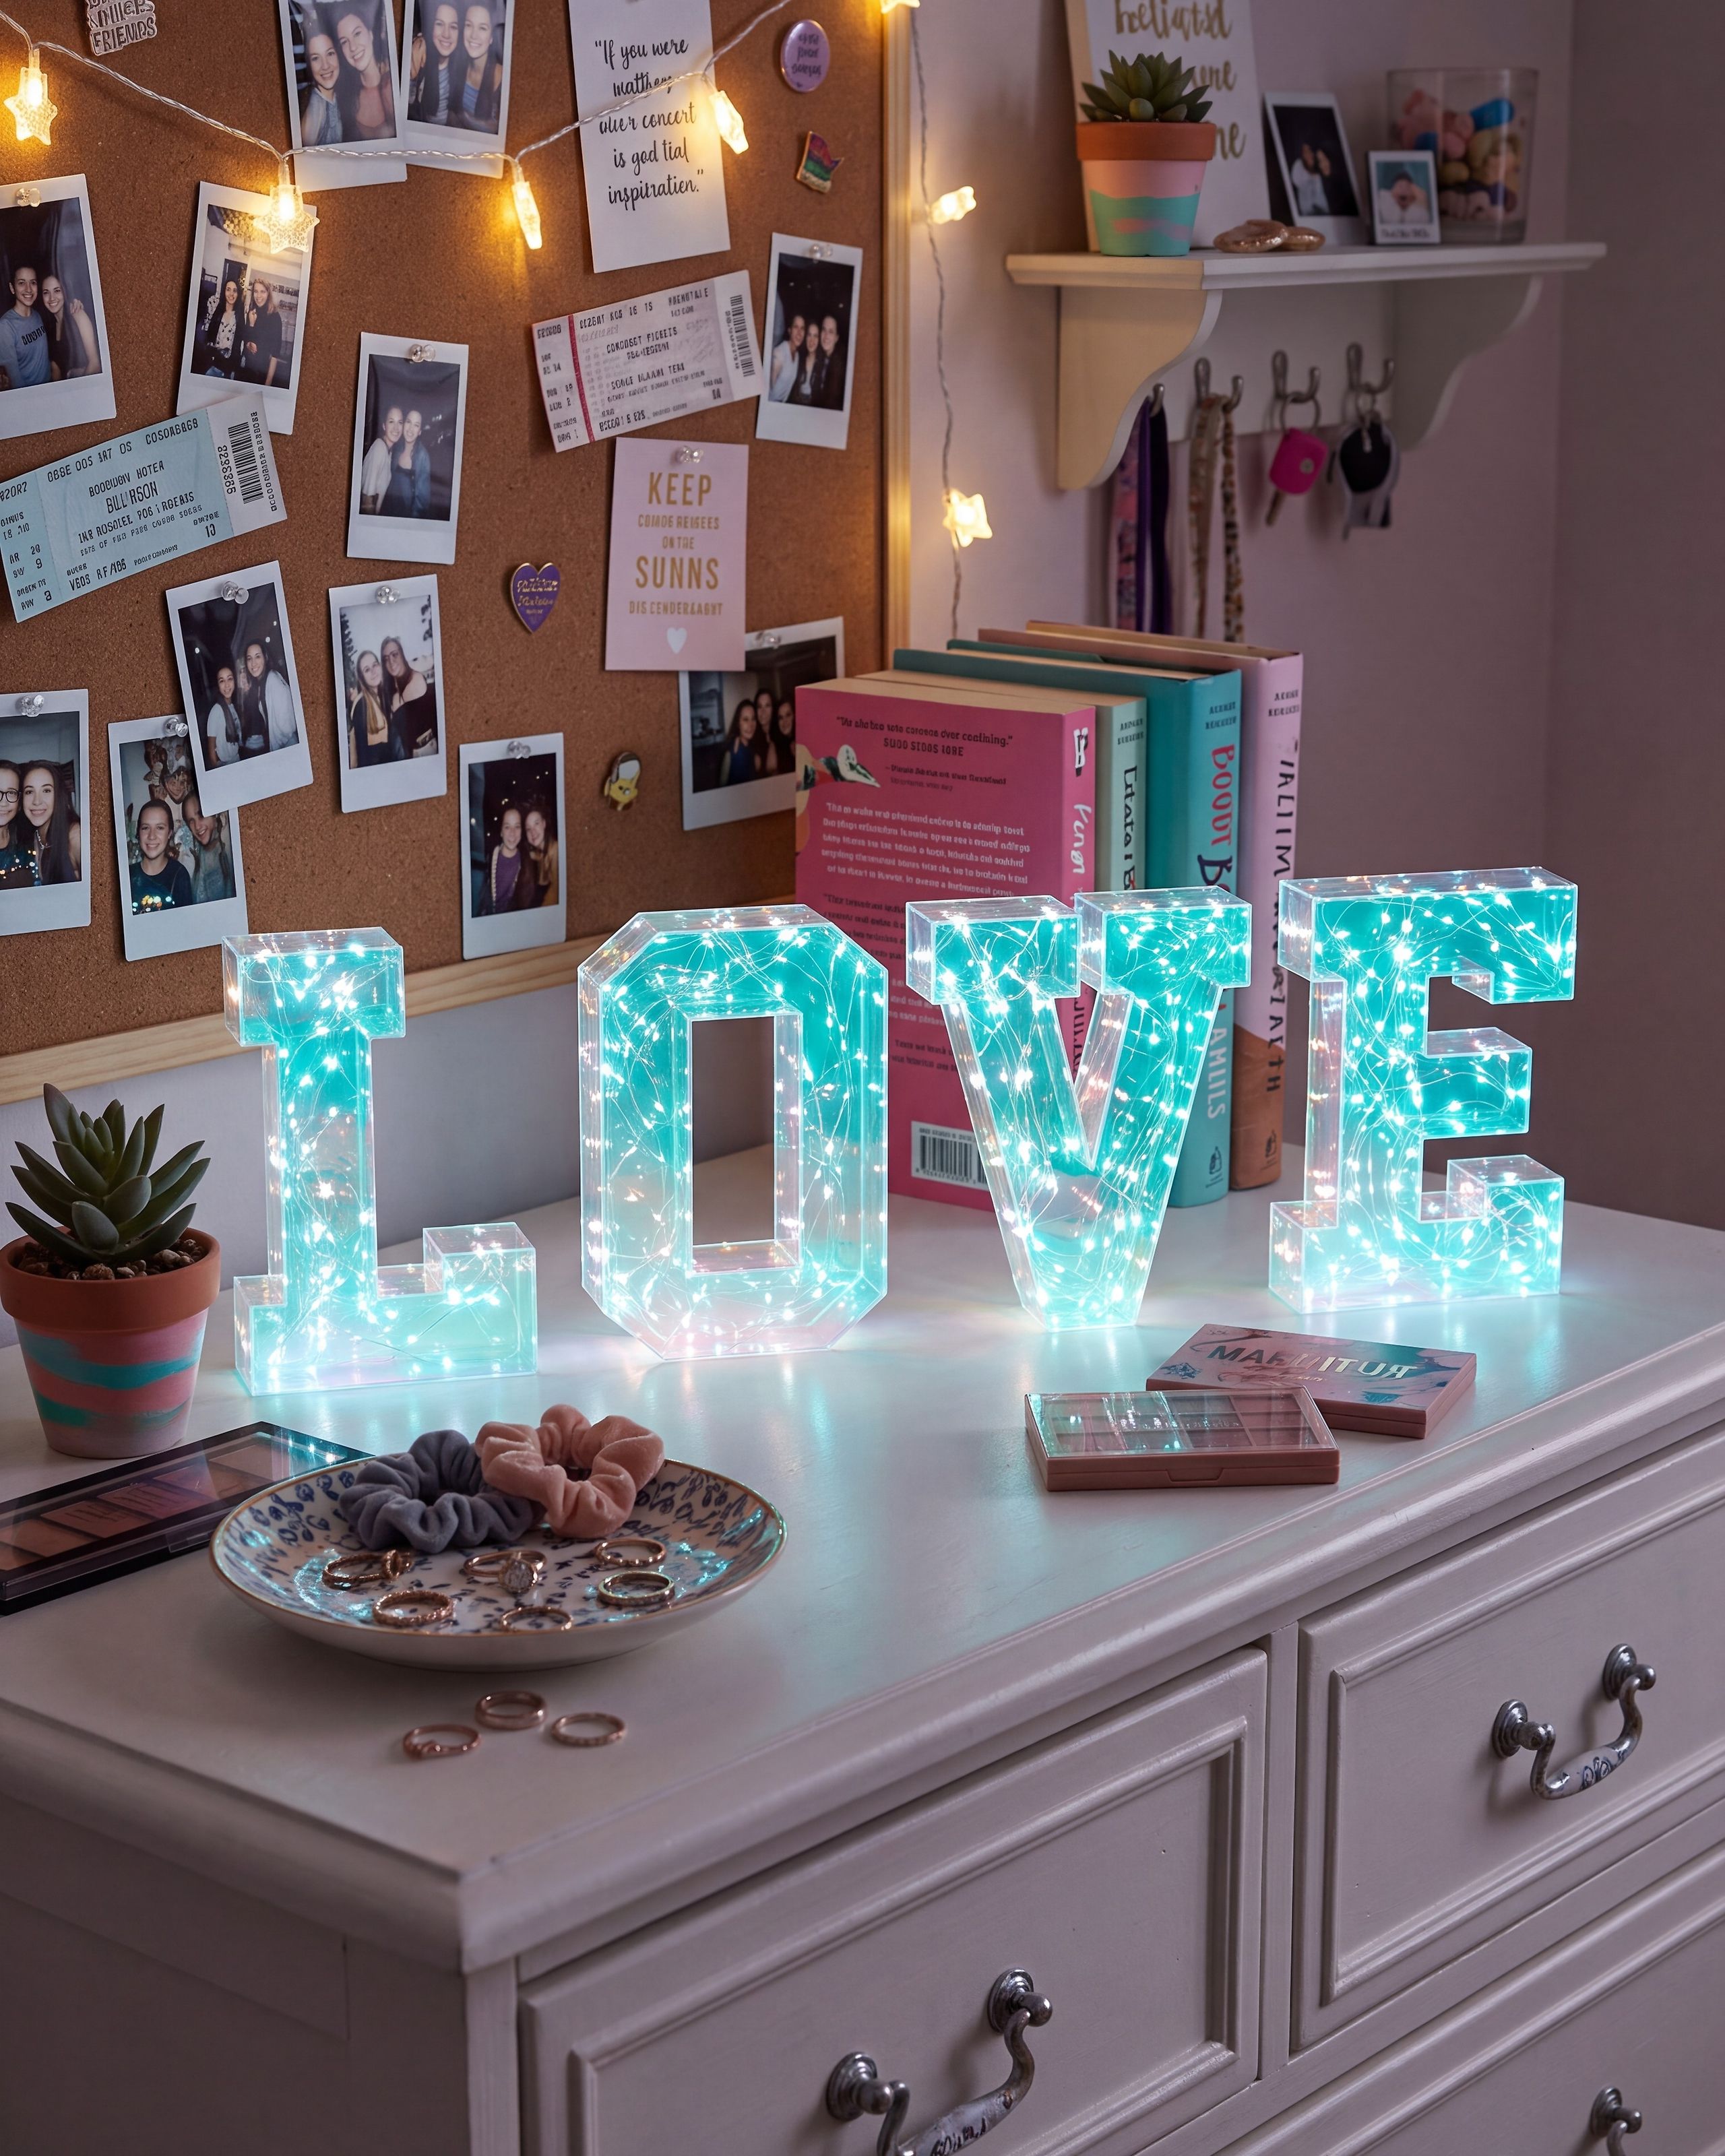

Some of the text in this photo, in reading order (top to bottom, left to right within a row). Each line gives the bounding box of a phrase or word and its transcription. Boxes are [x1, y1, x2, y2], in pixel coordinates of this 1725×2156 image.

[621, 44, 648, 69] you
[652, 39, 689, 56] were
[614, 149, 626, 168] is
[648, 472, 712, 507] KEEP
[635, 555, 719, 590] SUNNS
[222, 866, 1579, 1396] LOVE
